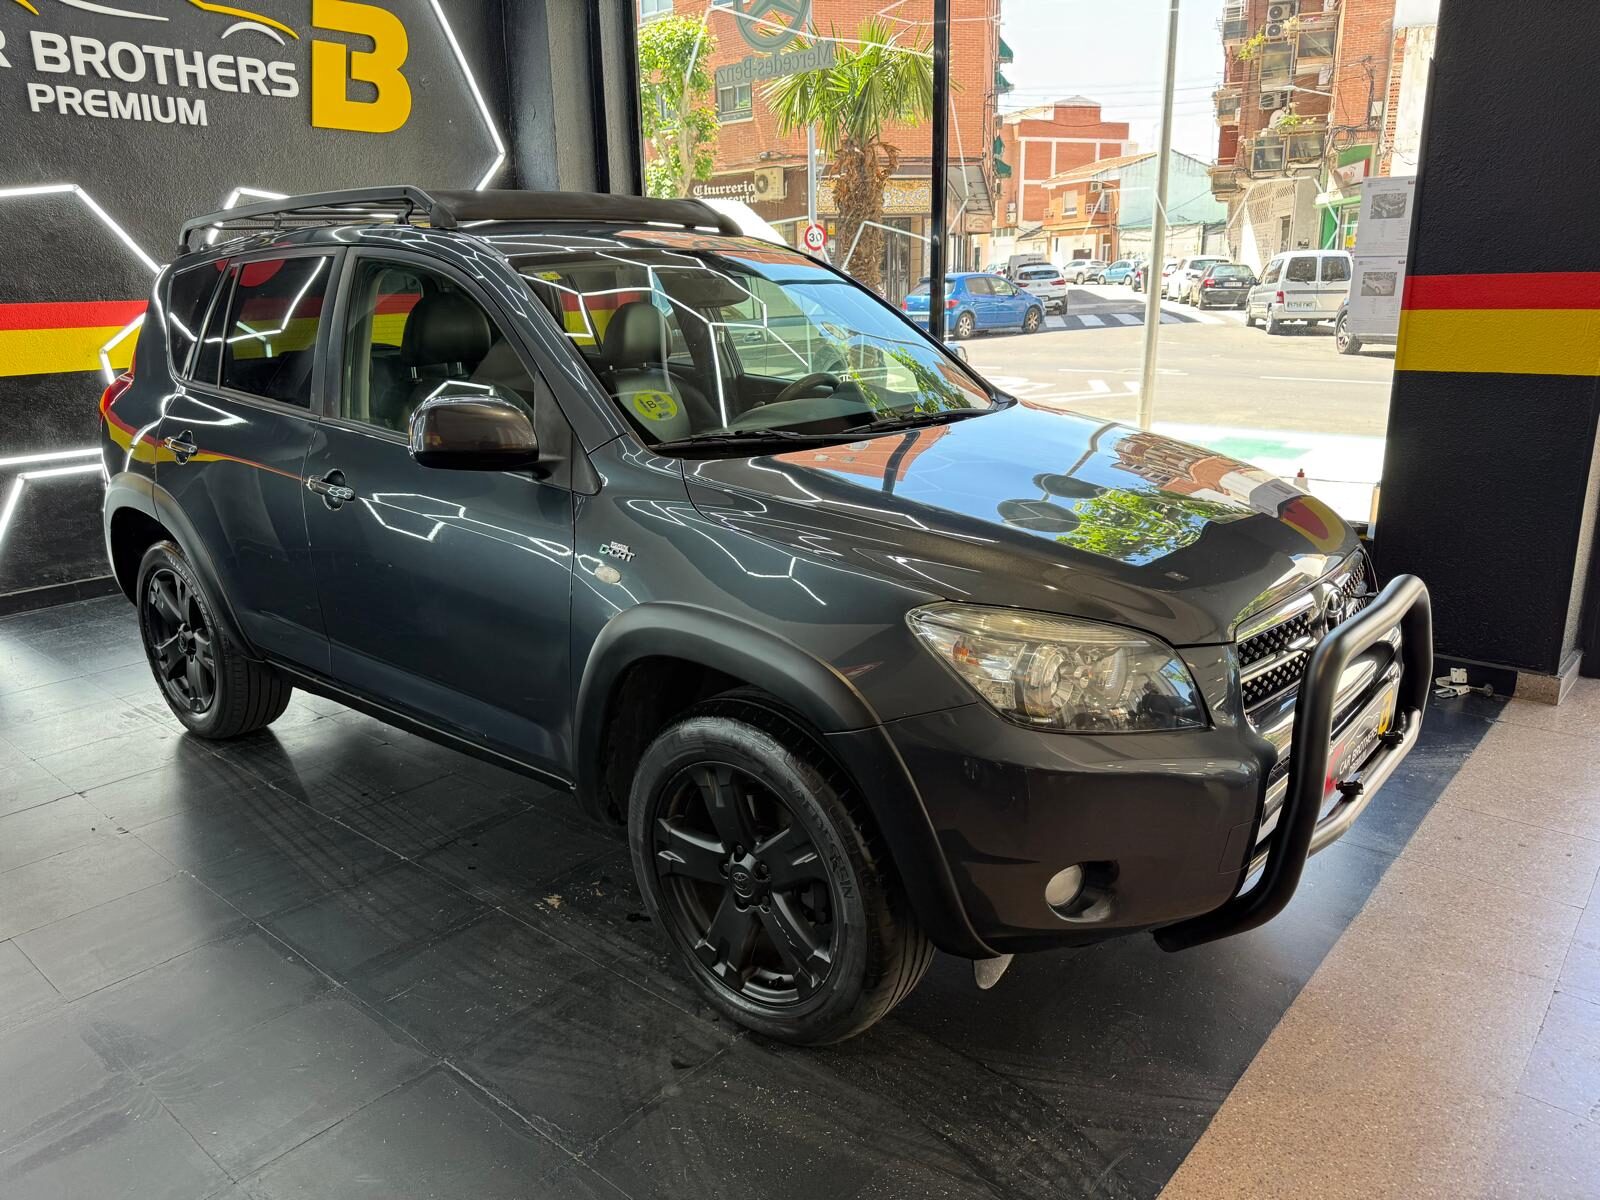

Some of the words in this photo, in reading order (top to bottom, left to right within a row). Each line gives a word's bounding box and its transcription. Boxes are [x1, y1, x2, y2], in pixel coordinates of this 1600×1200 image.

[30, 30, 299, 98] BROTHERS
[27, 83, 208, 126] PREMIUM
[808, 232, 822, 242] 30
